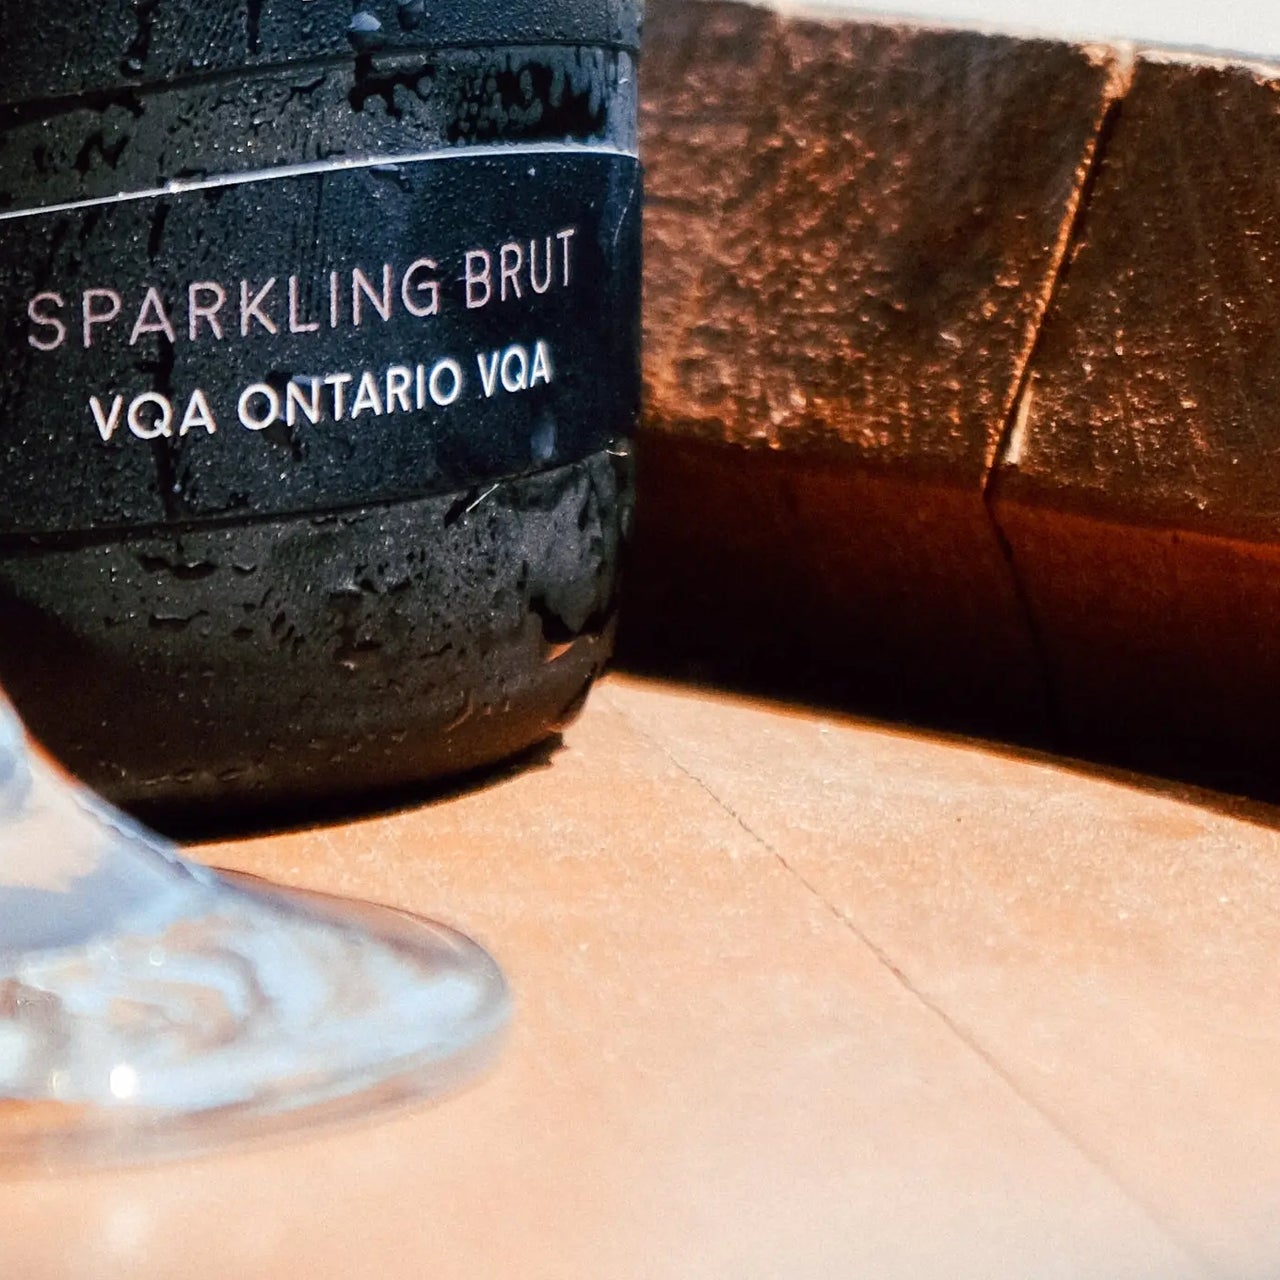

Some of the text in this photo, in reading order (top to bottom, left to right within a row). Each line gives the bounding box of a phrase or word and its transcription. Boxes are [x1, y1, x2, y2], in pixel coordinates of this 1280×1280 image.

[26, 227, 577, 352] SPARKLING BRUT
[88, 340, 552, 442] VQA ONTARIO VQA
